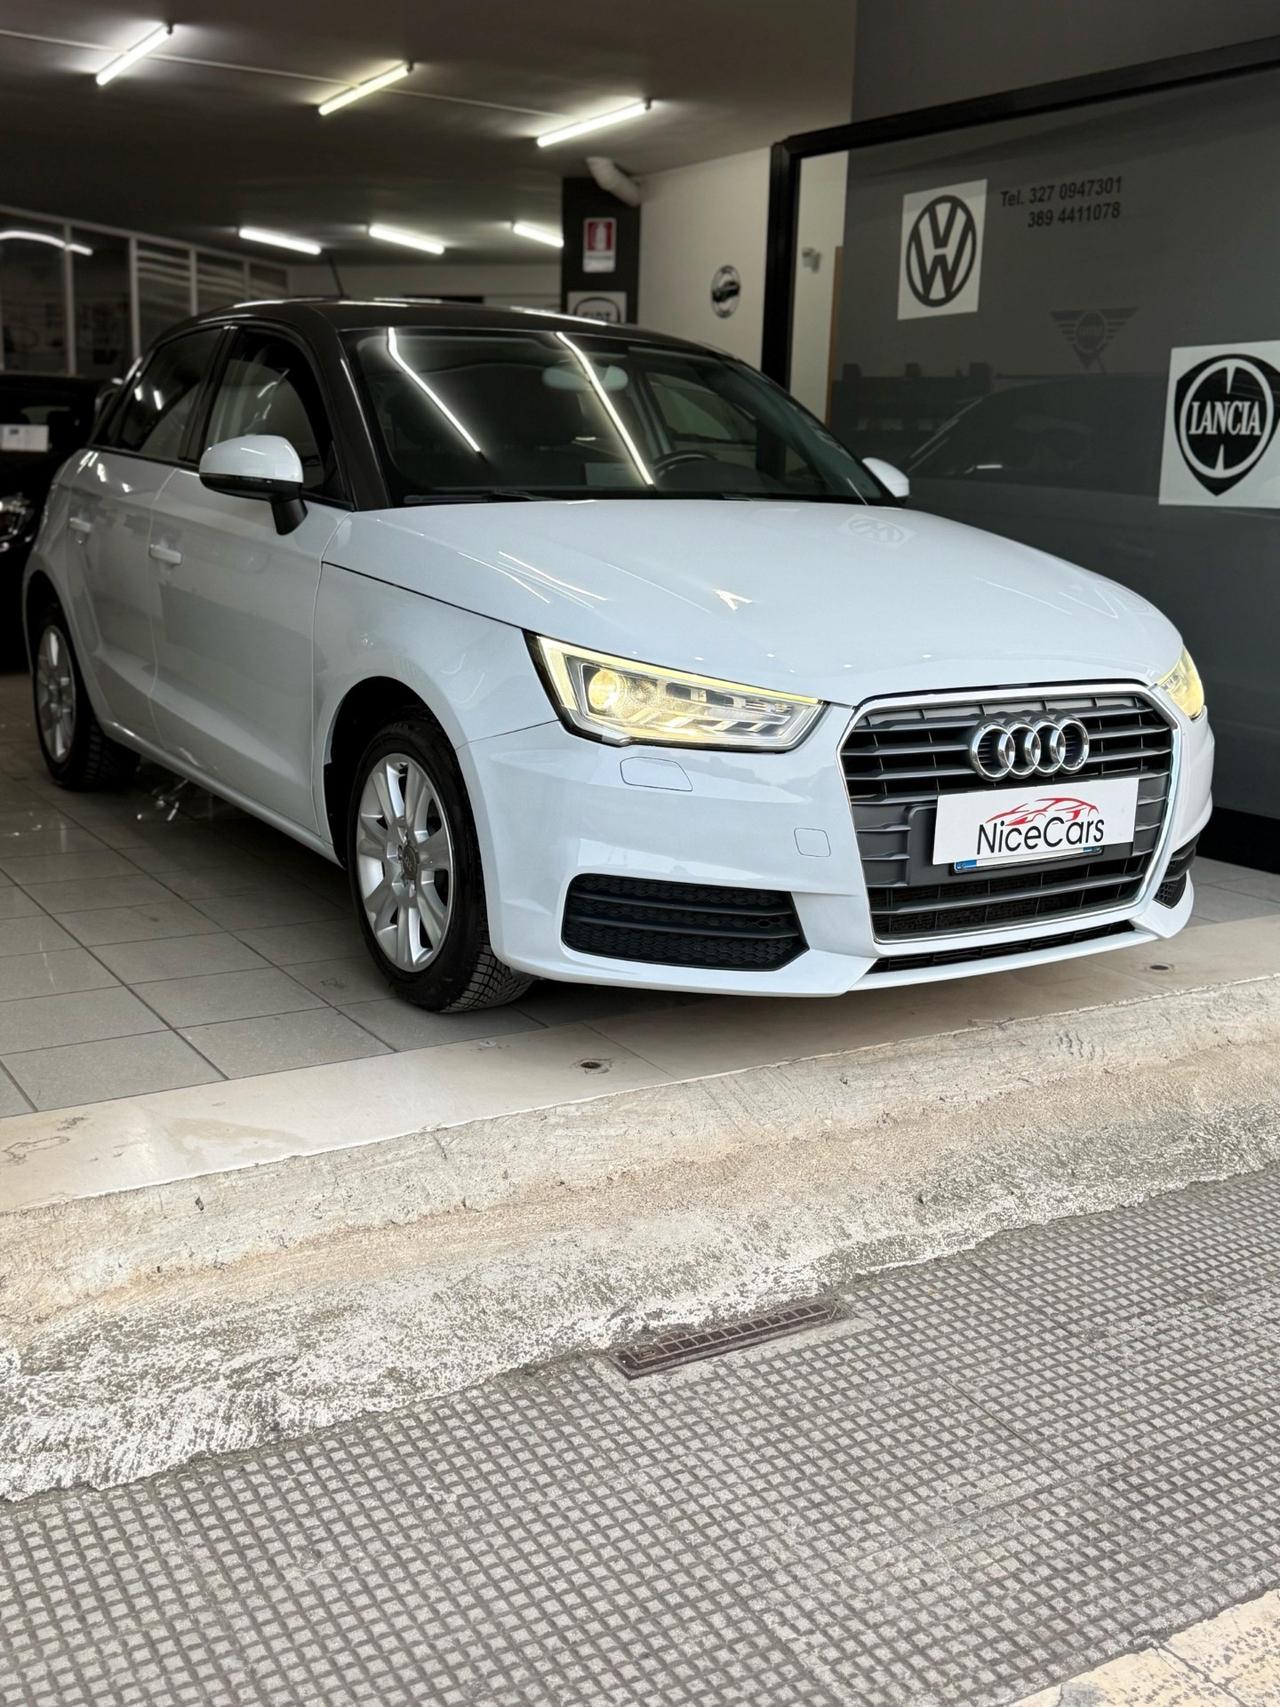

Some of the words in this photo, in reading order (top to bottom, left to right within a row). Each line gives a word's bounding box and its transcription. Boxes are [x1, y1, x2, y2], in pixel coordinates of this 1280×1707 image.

[1000, 189, 1024, 207] Tel.
[1029, 184, 1056, 204] 327
[1059, 175, 1122, 200] 0947301
[1027, 209, 1054, 228] 389
[1057, 201, 1121, 224] 4411078
[1188, 401, 1262, 435] LANCIA
[976, 816, 1105, 855] NiceCars
